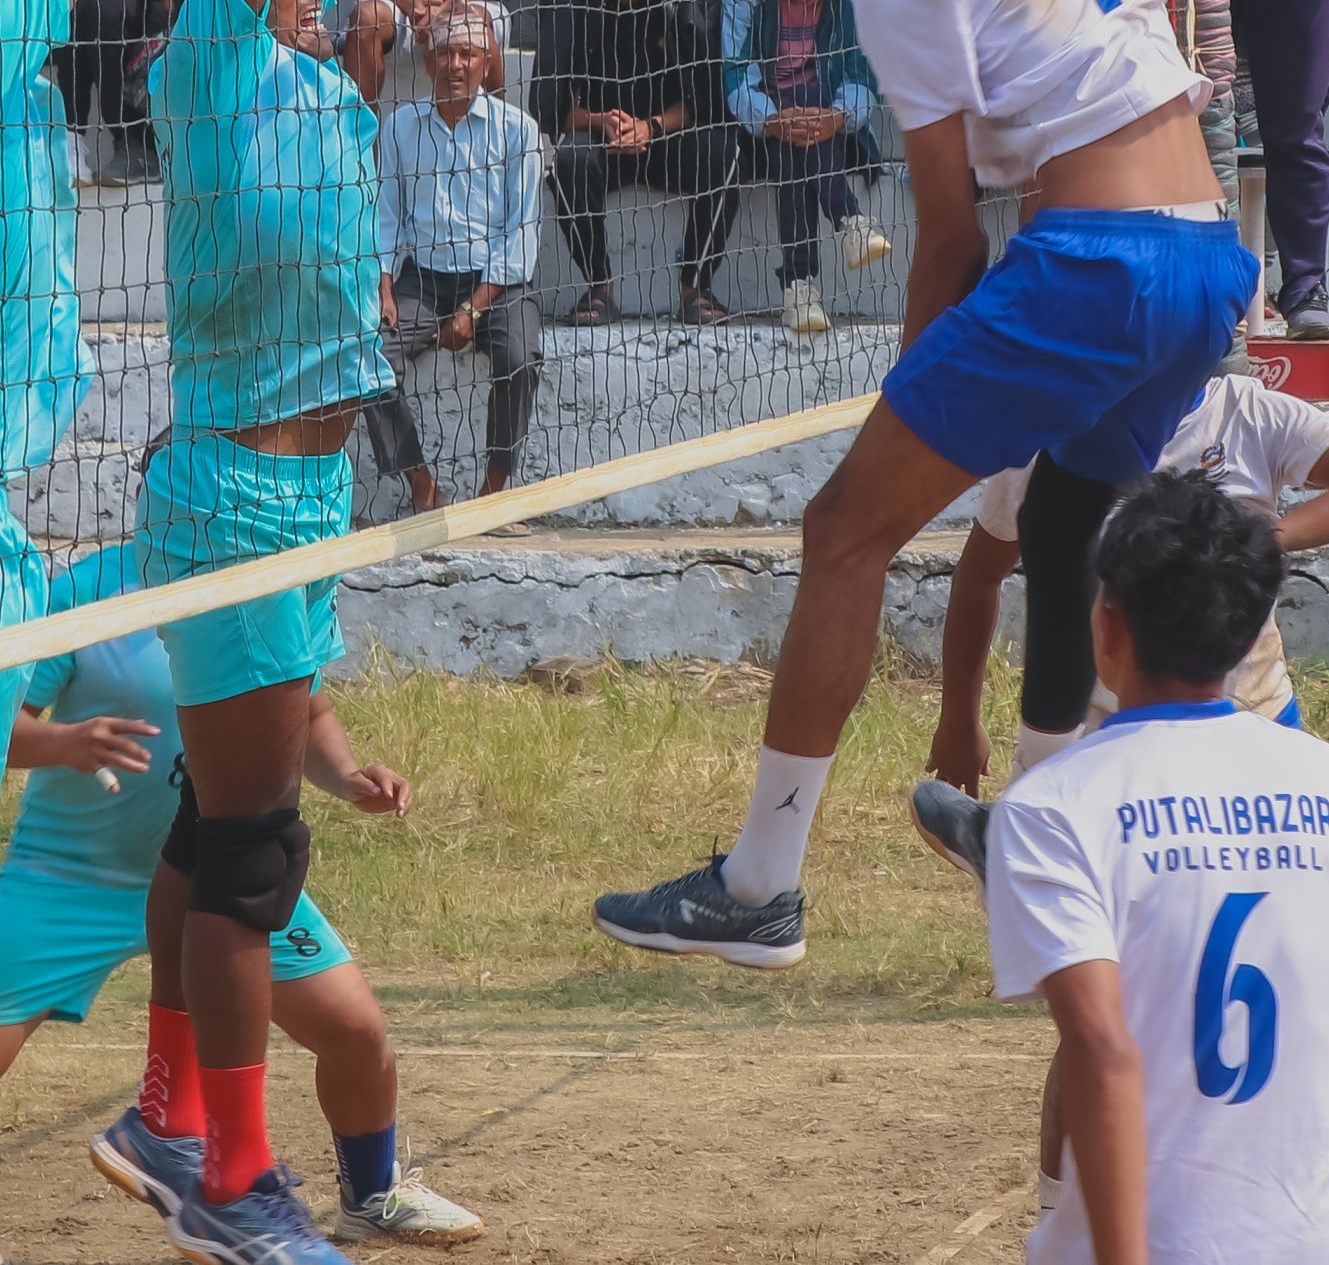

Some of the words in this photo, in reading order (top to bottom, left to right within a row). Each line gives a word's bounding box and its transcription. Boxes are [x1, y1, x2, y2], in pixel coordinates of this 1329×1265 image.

[1142, 844, 1325, 874] VOLLEYBALL
[286, 926, 322, 958] 8
[1194, 891, 1278, 1106] 6
